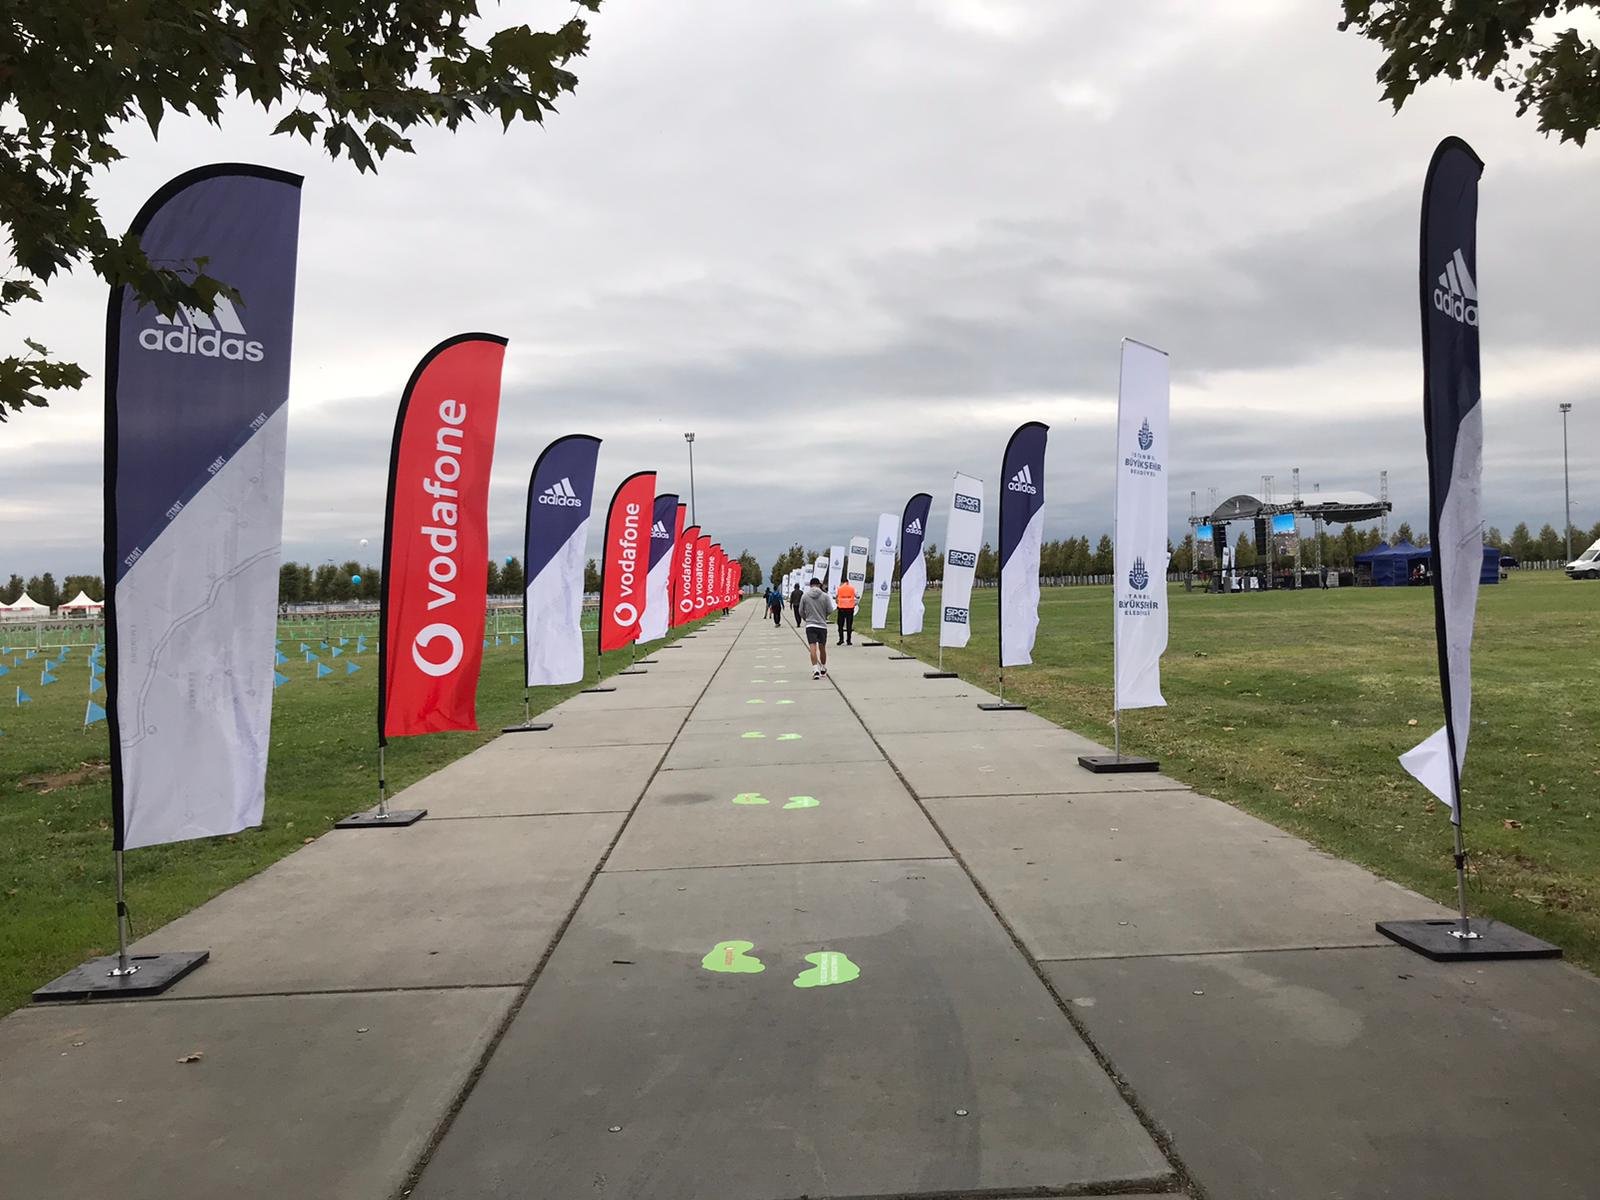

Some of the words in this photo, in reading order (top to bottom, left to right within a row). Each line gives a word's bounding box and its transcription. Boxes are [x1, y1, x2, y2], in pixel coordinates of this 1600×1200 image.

[1434, 288, 1479, 327] adida
[138, 326, 265, 362] adidas
[249, 412, 268, 431] START
[207, 455, 227, 475] START
[1008, 481, 1037, 495] adidas
[165, 500, 185, 520] START
[420, 398, 467, 611] vodafone
[538, 494, 582, 507] adidas
[956, 495, 979, 507] SPOR
[905, 527, 923, 536] adida
[124, 546, 143, 567] START
[618, 502, 640, 598] vodafone
[950, 551, 975, 562] SPOR
[681, 542, 693, 596] vodafone
